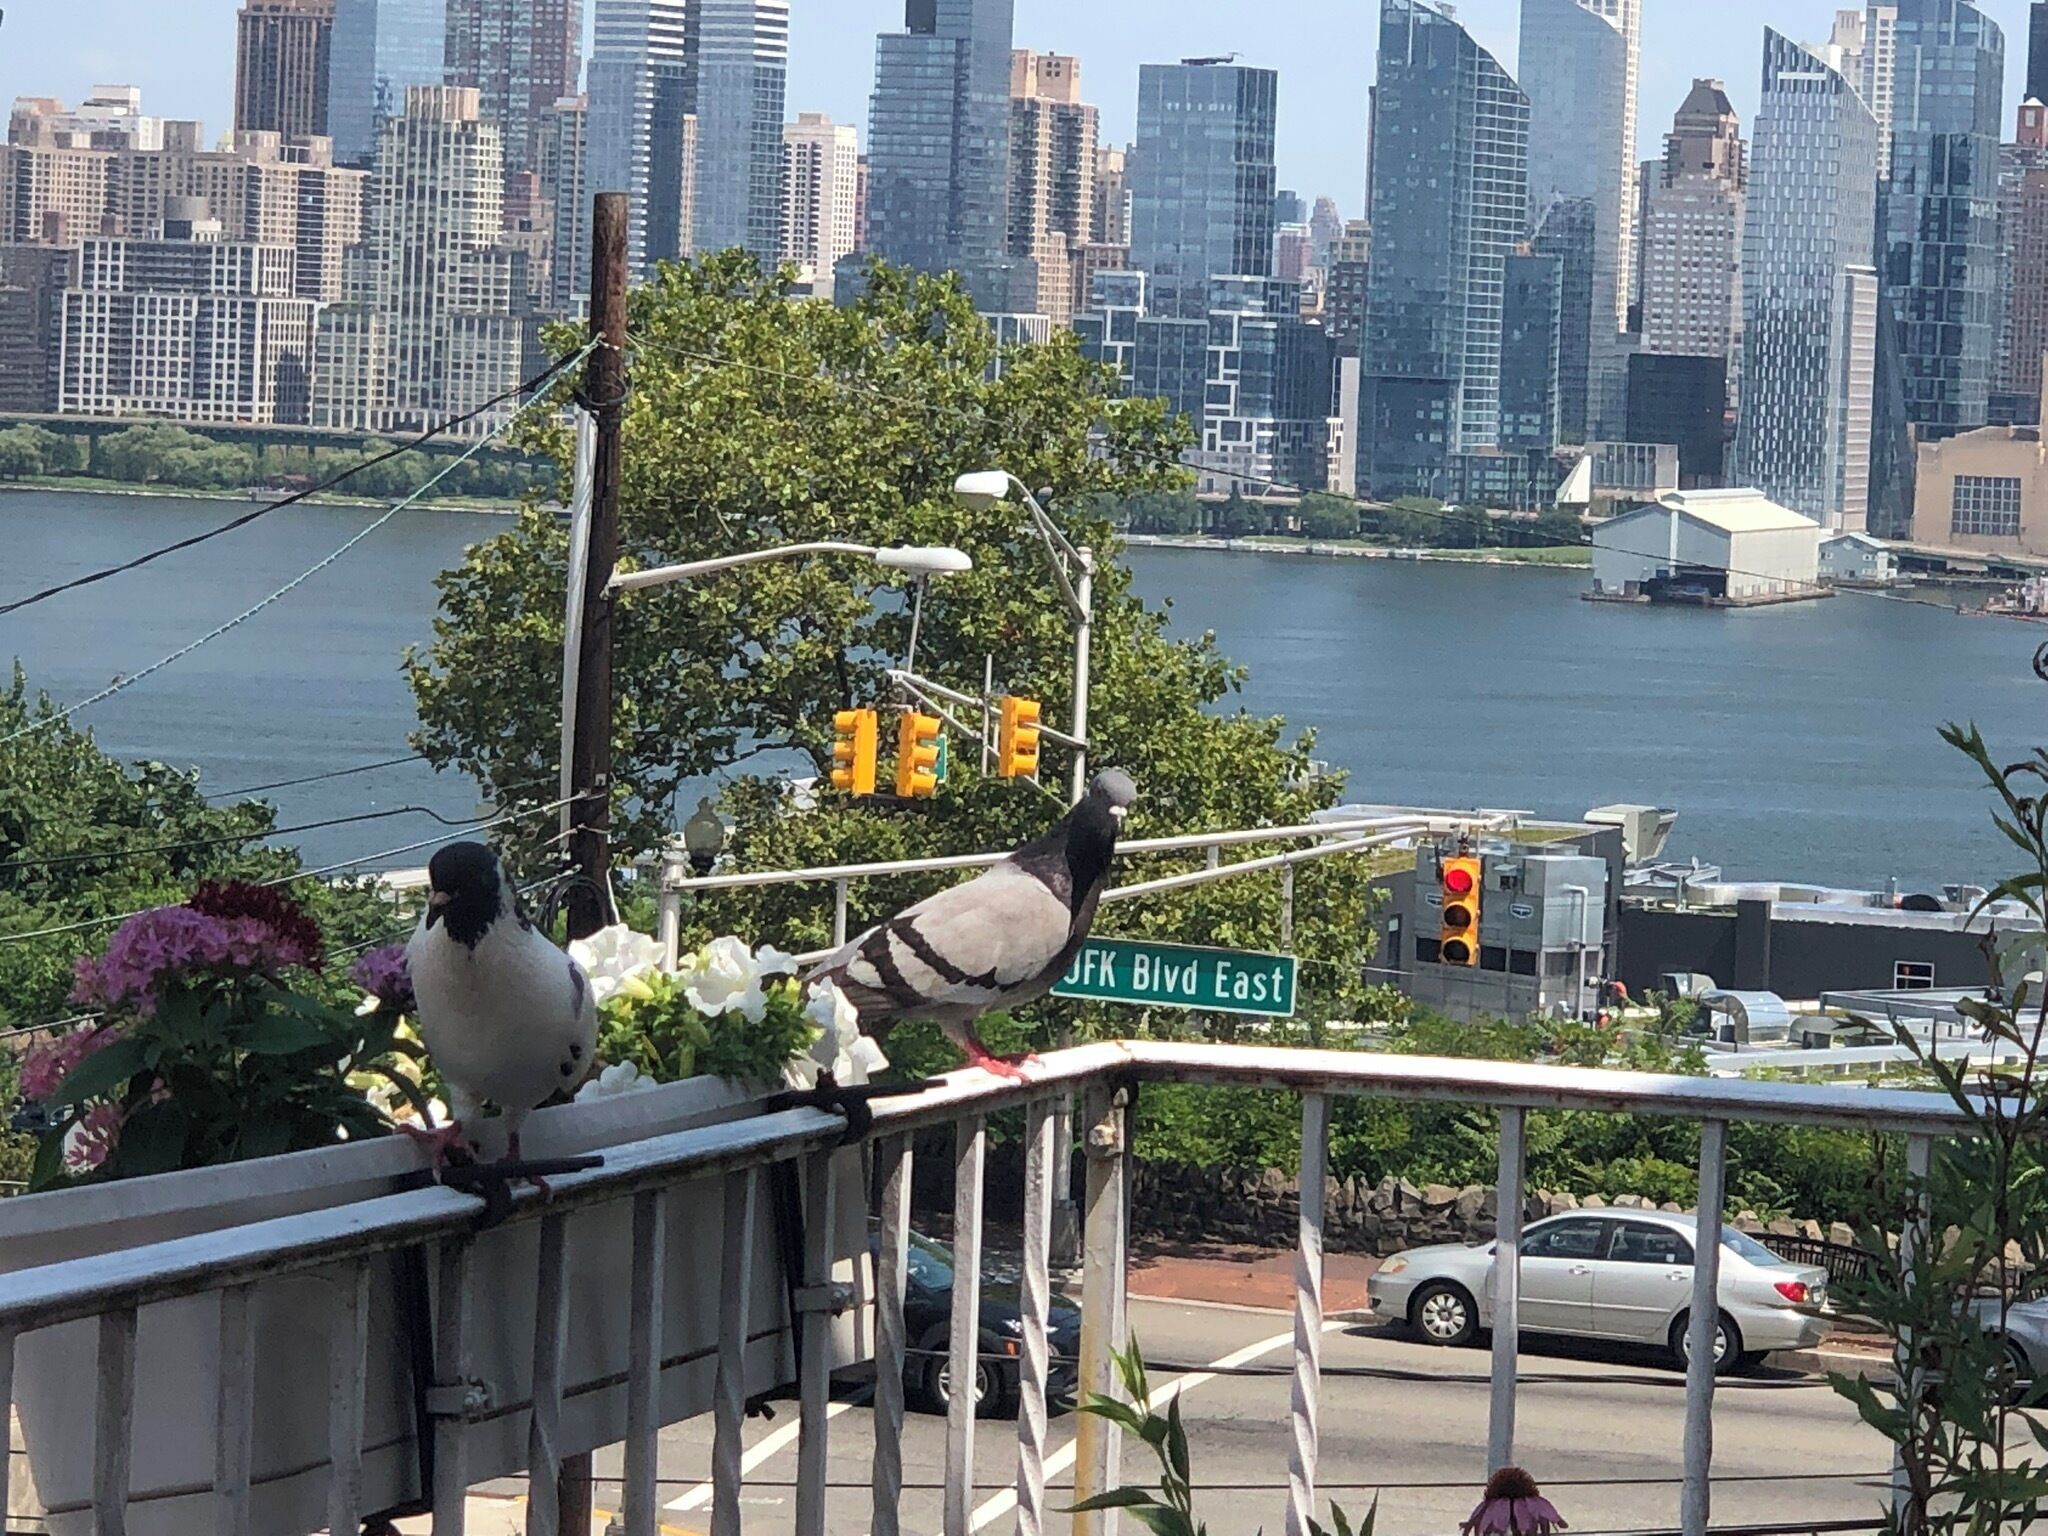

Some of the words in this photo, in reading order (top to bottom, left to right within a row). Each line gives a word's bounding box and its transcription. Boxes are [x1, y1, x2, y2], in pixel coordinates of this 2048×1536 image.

[1063, 949, 1116, 988] JFK
[1133, 953, 1198, 996] Blvd
[1215, 960, 1284, 1003] East
